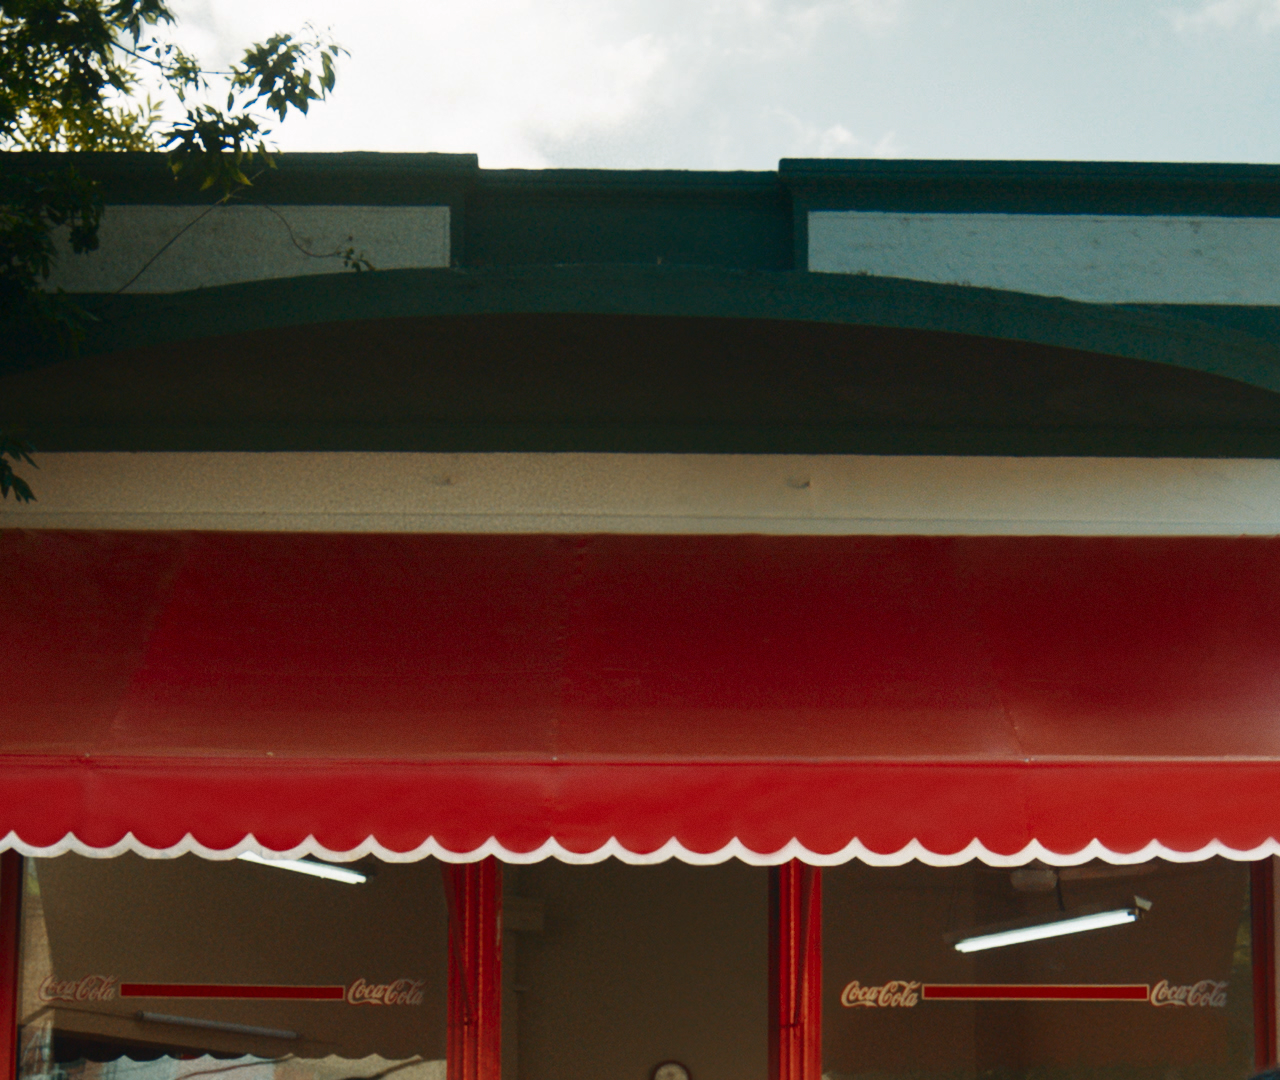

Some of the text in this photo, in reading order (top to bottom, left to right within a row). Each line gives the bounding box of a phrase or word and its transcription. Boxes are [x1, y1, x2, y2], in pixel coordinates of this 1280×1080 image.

[38, 973, 118, 1003] Coca-Cola
[346, 977, 425, 1006] Coca-Cola
[841, 979, 921, 1008] Coca-Cola
[1149, 978, 1229, 1008] Coca-Cola
